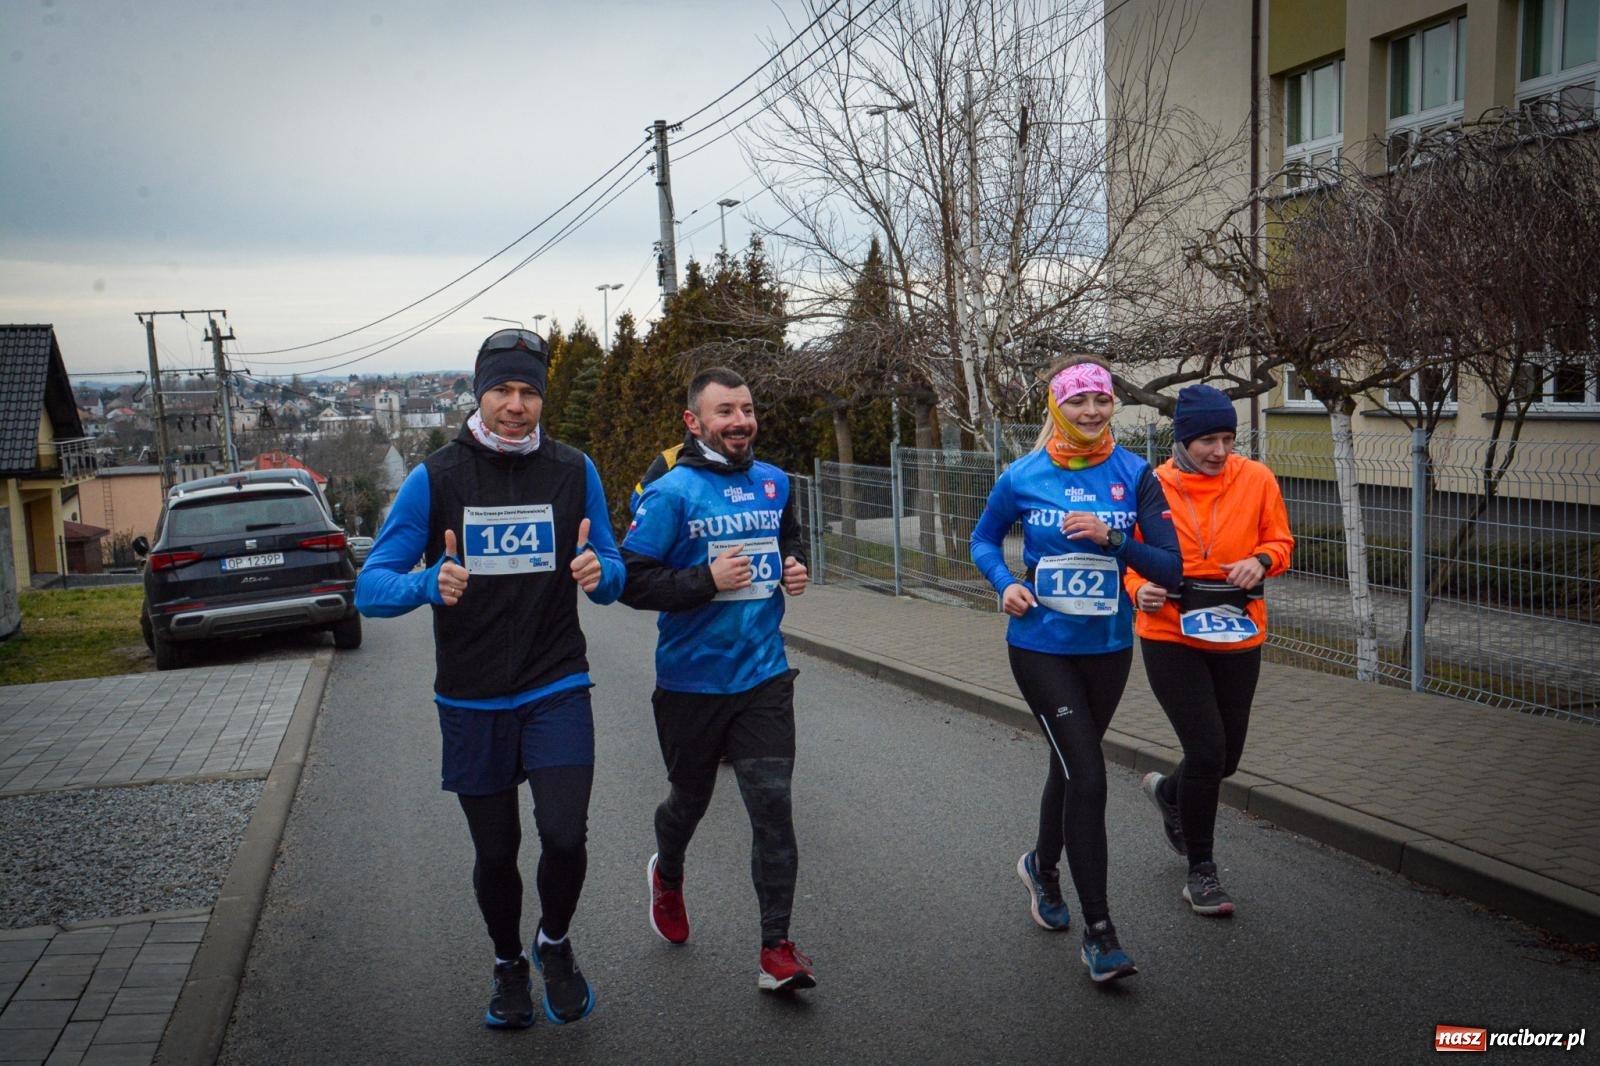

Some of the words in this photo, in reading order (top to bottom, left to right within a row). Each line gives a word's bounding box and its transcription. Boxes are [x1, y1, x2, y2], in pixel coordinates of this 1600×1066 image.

[1028, 509, 1137, 529] RUERS
[480, 523, 540, 554] 164
[228, 558, 242, 569] OP
[248, 553, 281, 567] 1239P
[1051, 570, 1104, 596] 162
[1195, 613, 1245, 632] 151
